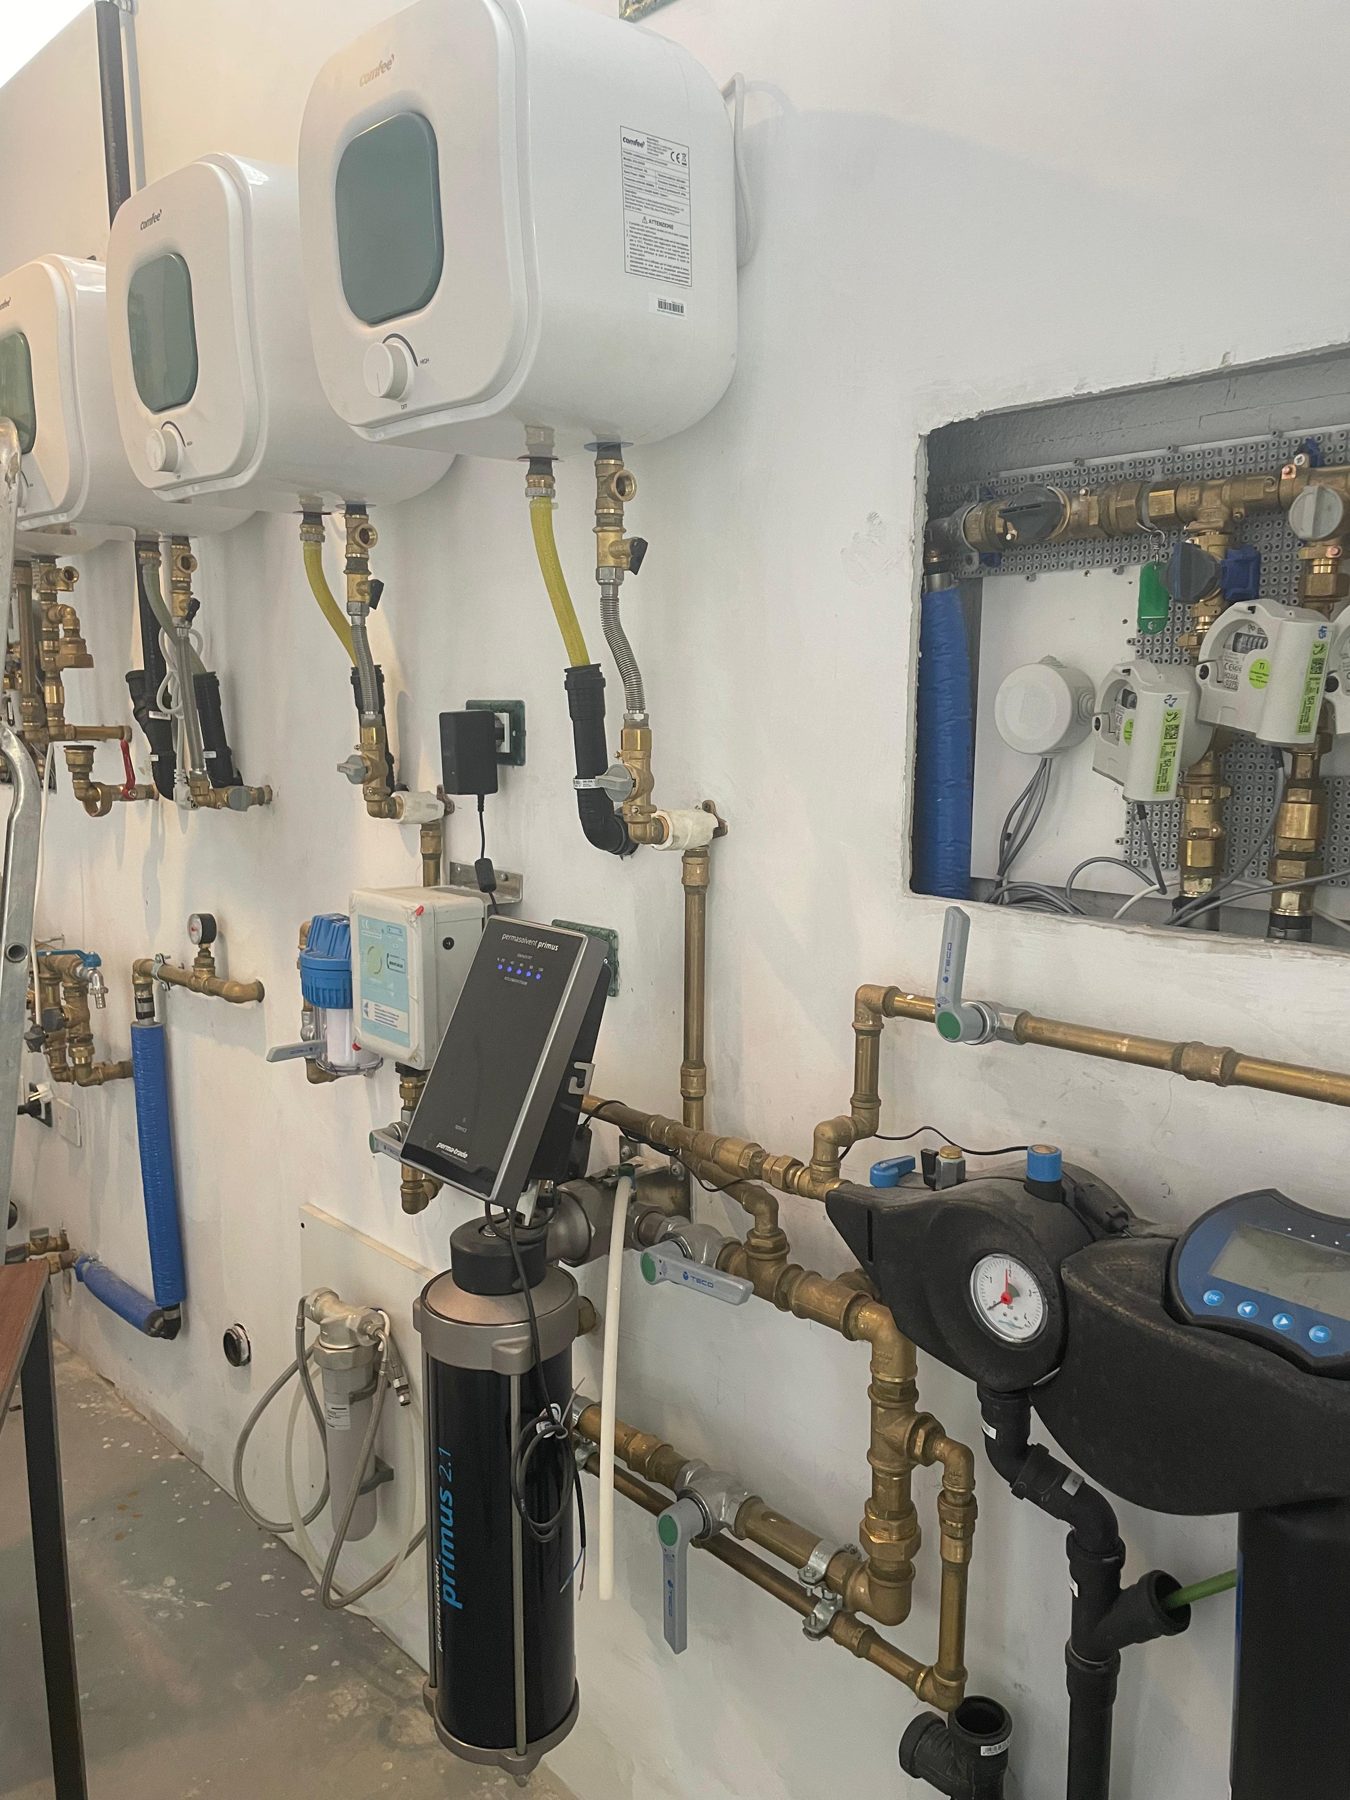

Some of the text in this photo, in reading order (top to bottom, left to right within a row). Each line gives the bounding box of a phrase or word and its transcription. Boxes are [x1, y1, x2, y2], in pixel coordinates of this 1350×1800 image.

[501, 933, 559, 952] permasolvent primus
[690, 1275, 714, 1288] TECO
[438, 1446, 464, 1610] primus 2.1
